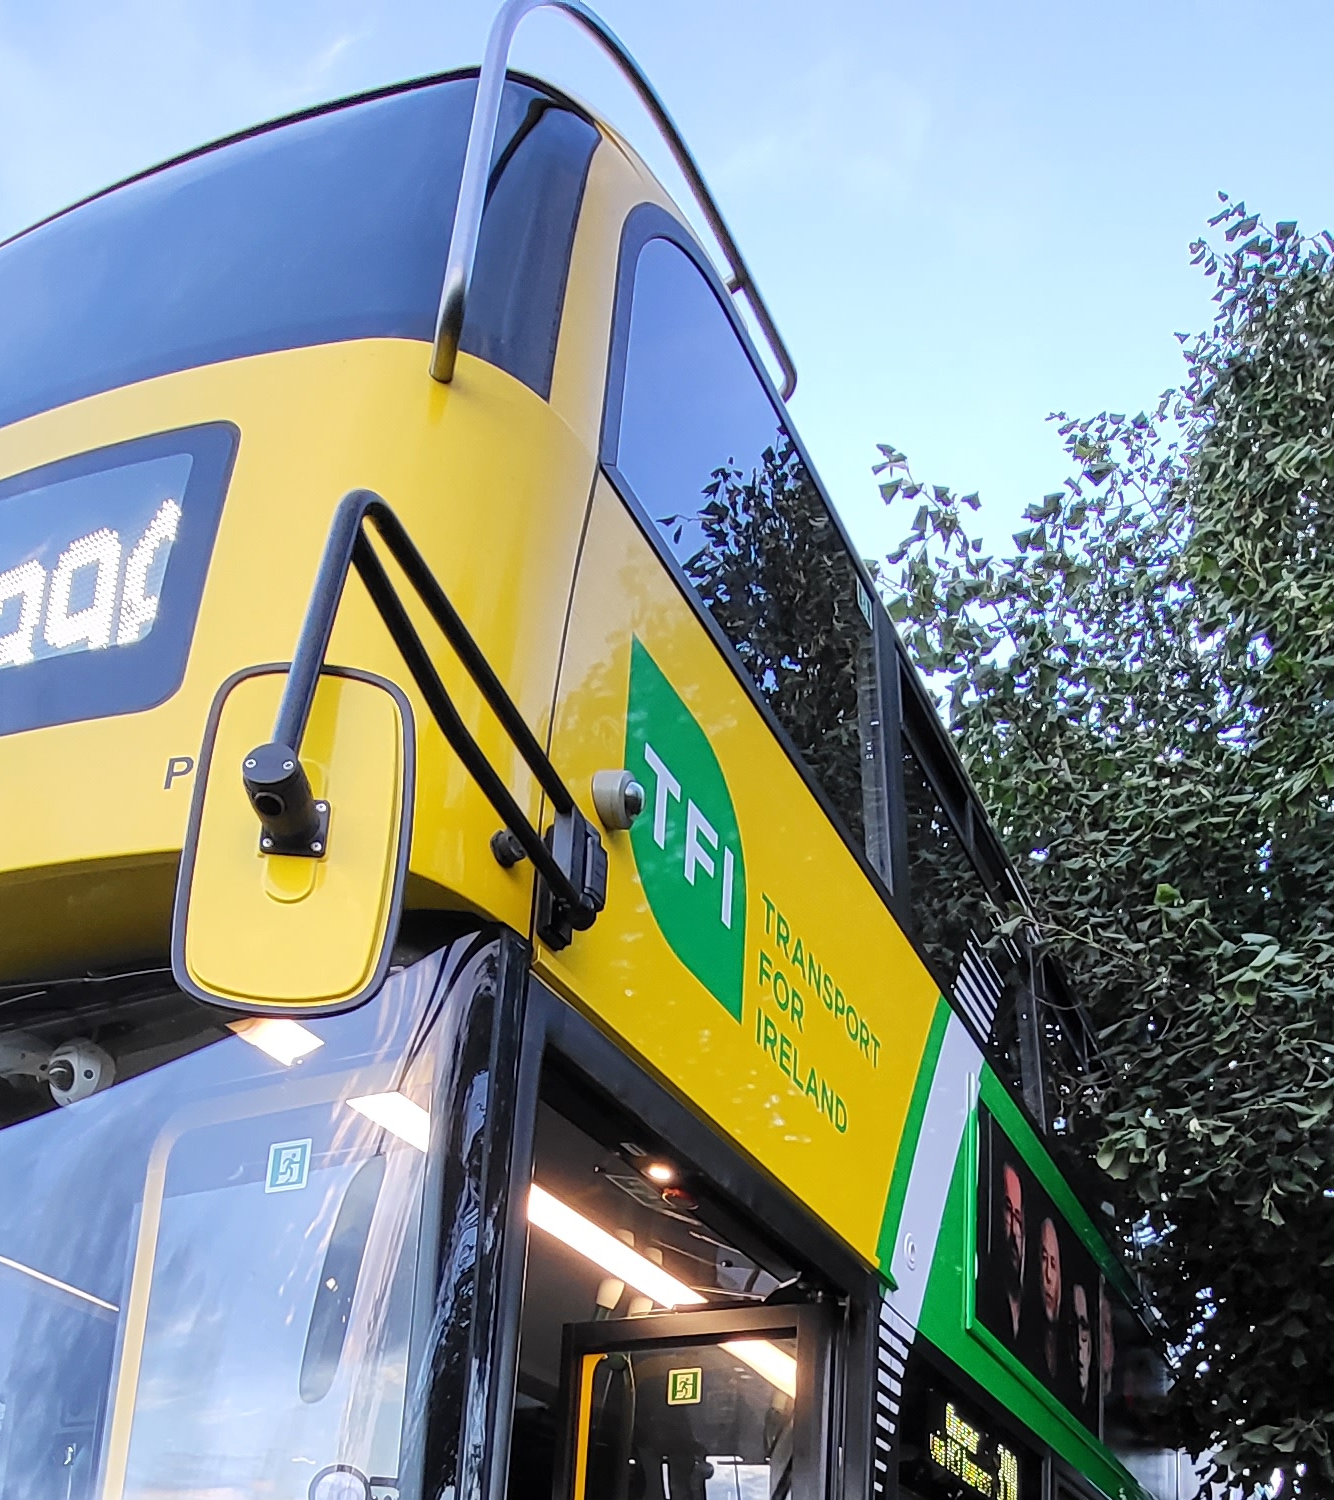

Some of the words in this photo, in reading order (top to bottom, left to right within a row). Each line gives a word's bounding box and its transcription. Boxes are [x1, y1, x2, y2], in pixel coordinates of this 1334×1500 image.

[643, 742, 735, 930] TFI
[758, 952, 805, 1034] FOR
[760, 892, 881, 1070] TRANSPORT
[755, 1006, 849, 1134] IRELAND
